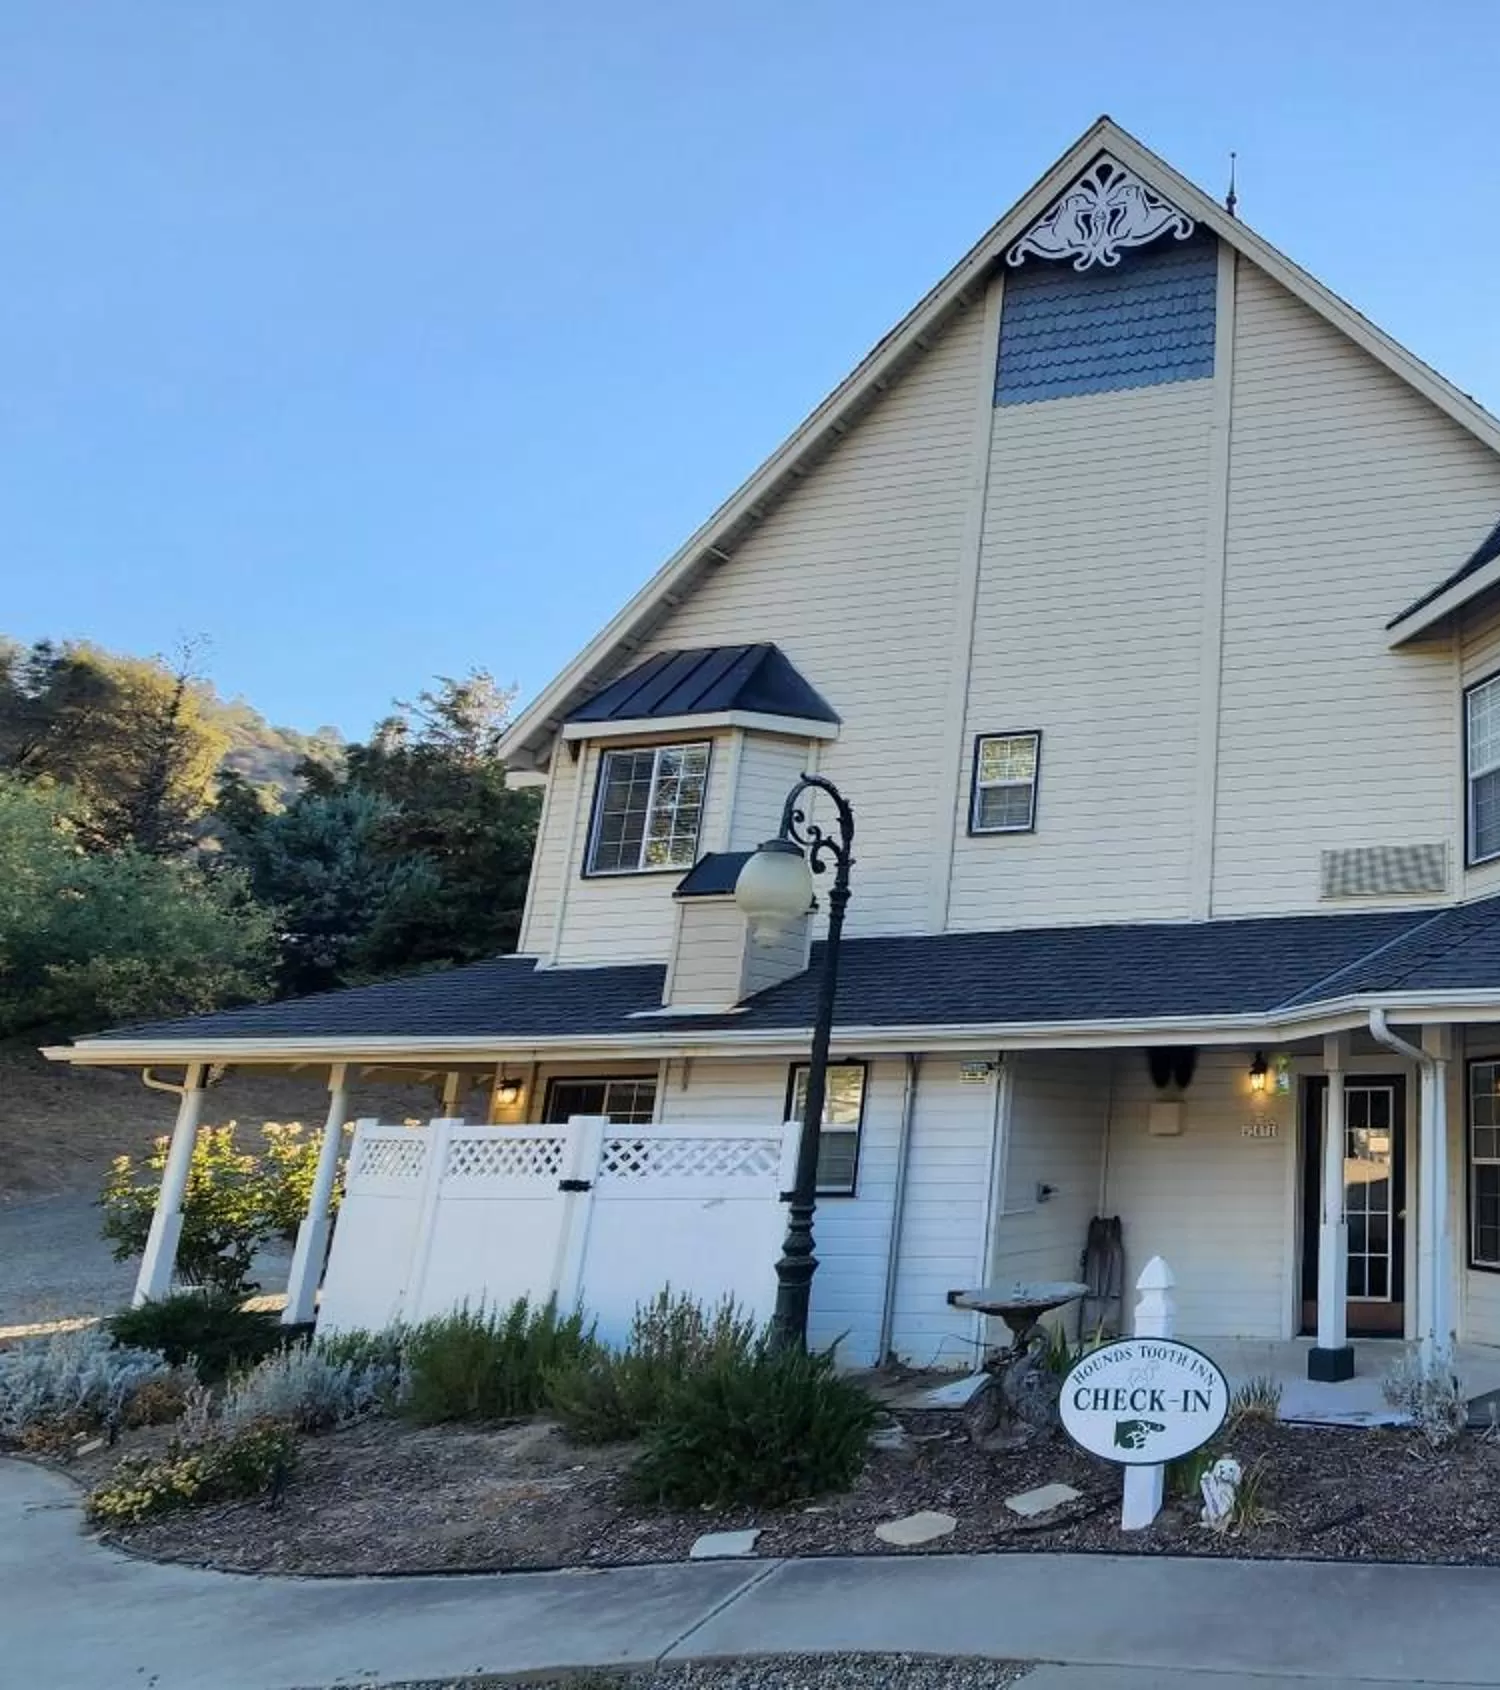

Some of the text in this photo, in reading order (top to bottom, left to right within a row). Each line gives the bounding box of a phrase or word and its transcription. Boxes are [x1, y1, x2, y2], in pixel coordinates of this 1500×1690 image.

[1072, 1345, 1217, 1386] HOUNDS TOOTH INN
[1073, 1387, 1213, 1412] CHECK-IN
